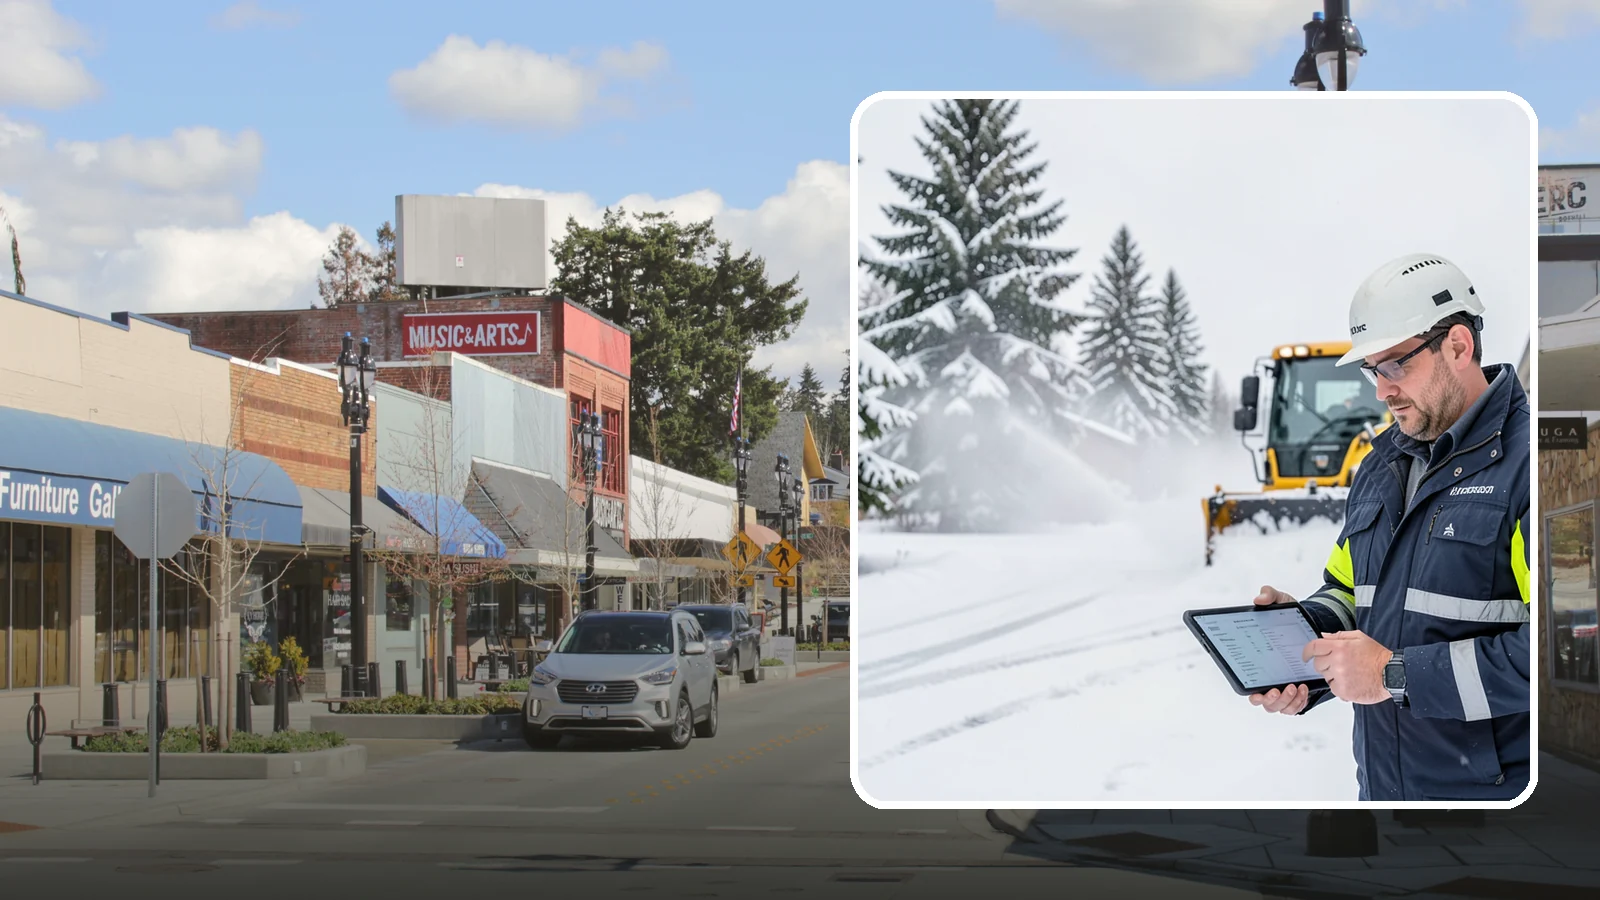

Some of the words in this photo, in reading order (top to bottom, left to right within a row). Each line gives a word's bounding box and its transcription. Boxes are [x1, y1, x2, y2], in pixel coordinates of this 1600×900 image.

[409, 323, 519, 349] MUSIC&ARTS
[0, 471, 79, 515] Furniture
[89, 482, 122, 519] Gal
[453, 563, 479, 574] SUSHI
